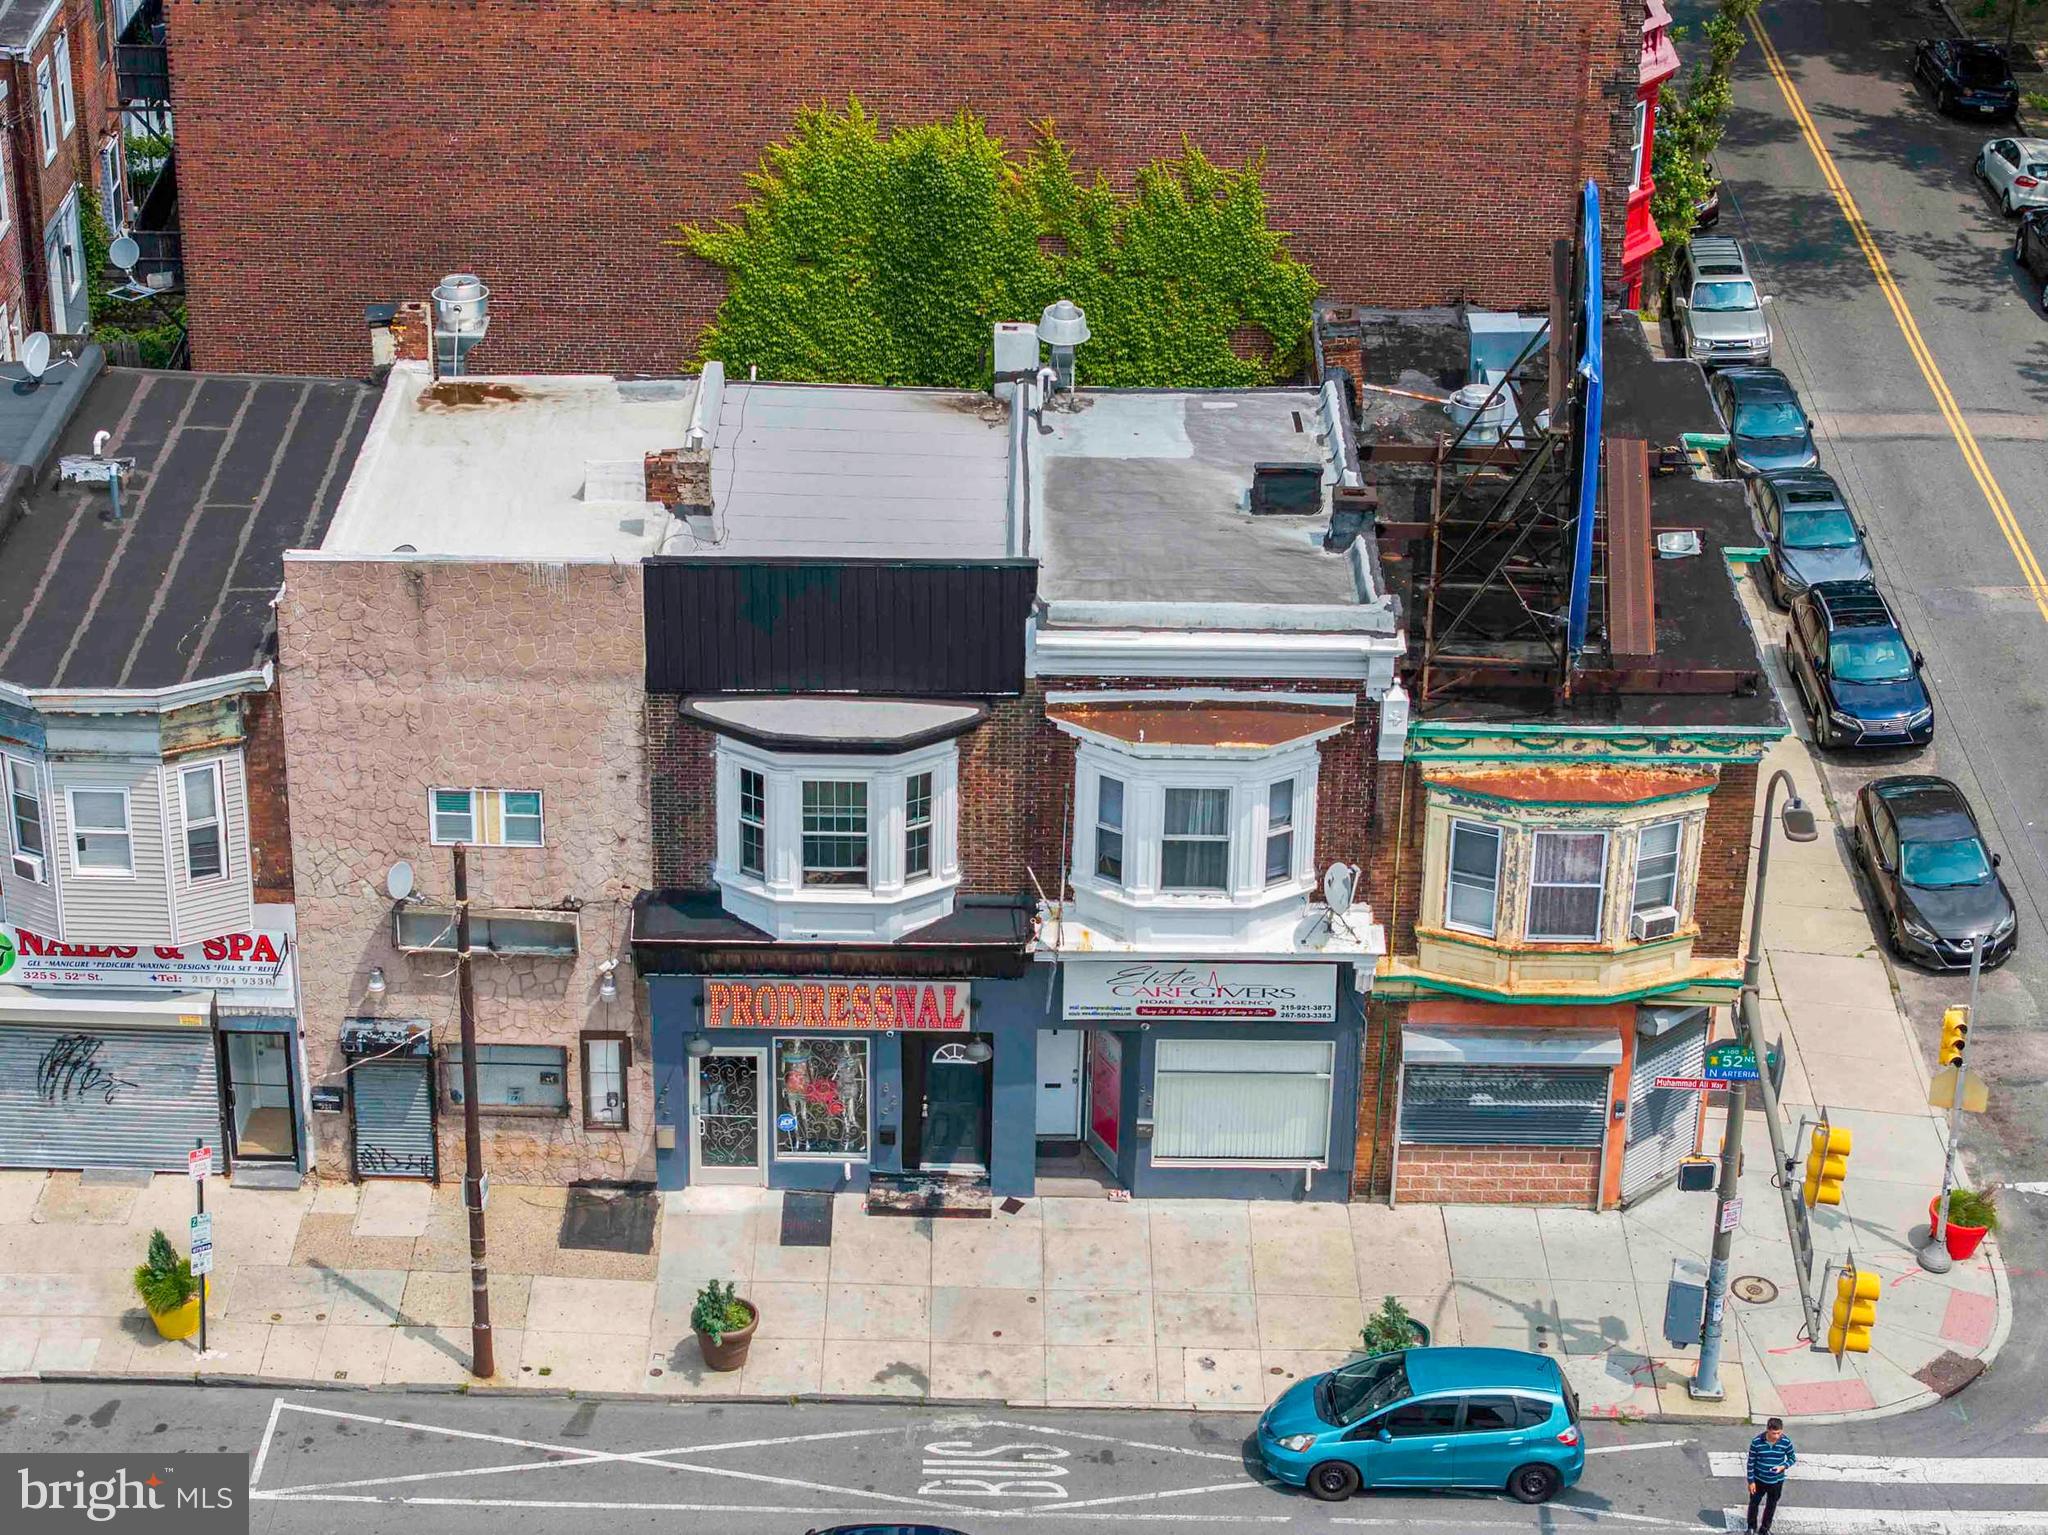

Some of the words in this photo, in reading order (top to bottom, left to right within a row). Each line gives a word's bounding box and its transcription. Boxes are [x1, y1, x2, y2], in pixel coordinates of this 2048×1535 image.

[202, 933, 280, 962] SPA
[23, 971, 47, 980] 325
[157, 974, 182, 983] Tel:
[192, 975, 211, 984] 215
[1112, 985, 1296, 998] CAREGIVERS
[709, 983, 965, 1029] PRODRESSNAL
[1709, 1069, 1718, 1078] N
[1656, 1078, 1697, 1088] Muhammad
[1699, 1080, 1709, 1088] Ali
[1711, 1080, 1723, 1089] Way
[918, 1441, 1071, 1498] BUS
